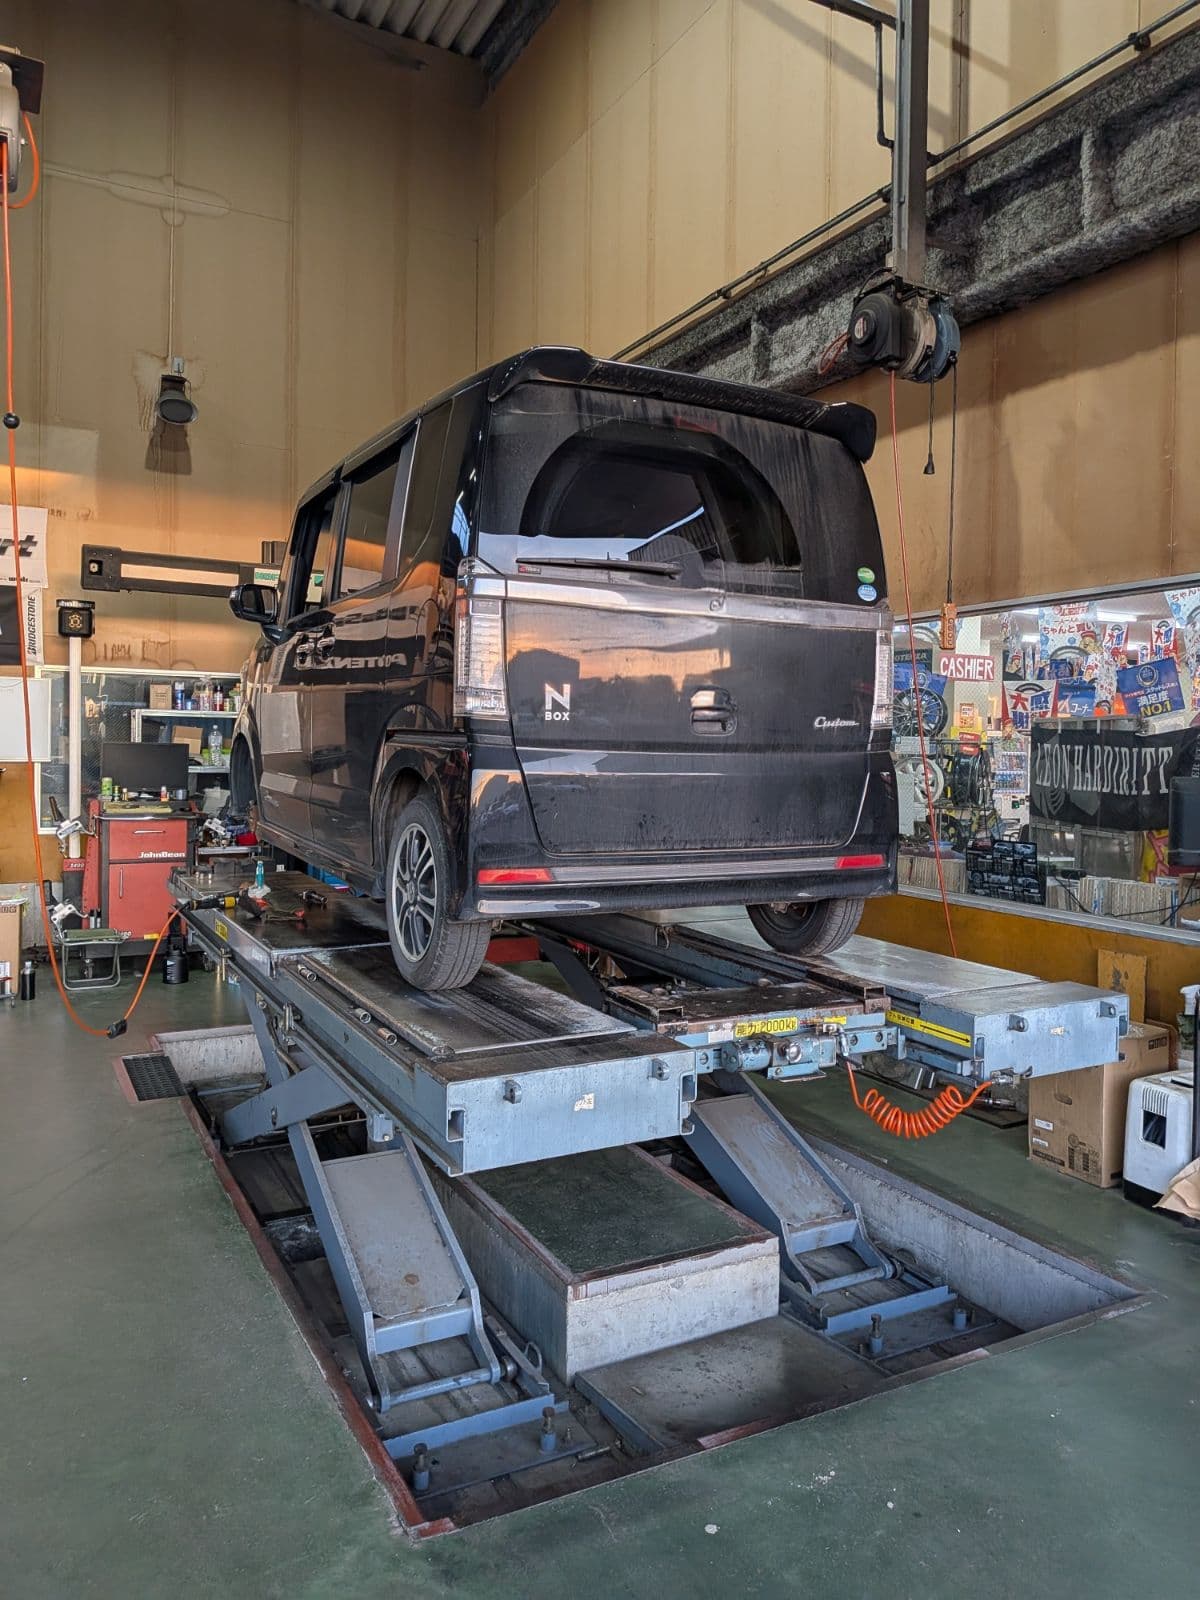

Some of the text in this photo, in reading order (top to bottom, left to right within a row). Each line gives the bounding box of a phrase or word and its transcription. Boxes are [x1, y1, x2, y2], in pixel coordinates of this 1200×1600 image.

[27, 595, 37, 656] BRIDGESTONE
[940, 657, 994, 680] CASHIER
[545, 683, 570, 710] N
[545, 711, 570, 721] BOX
[1140, 701, 1172, 717] NO.1
[814, 716, 860, 728] Custom
